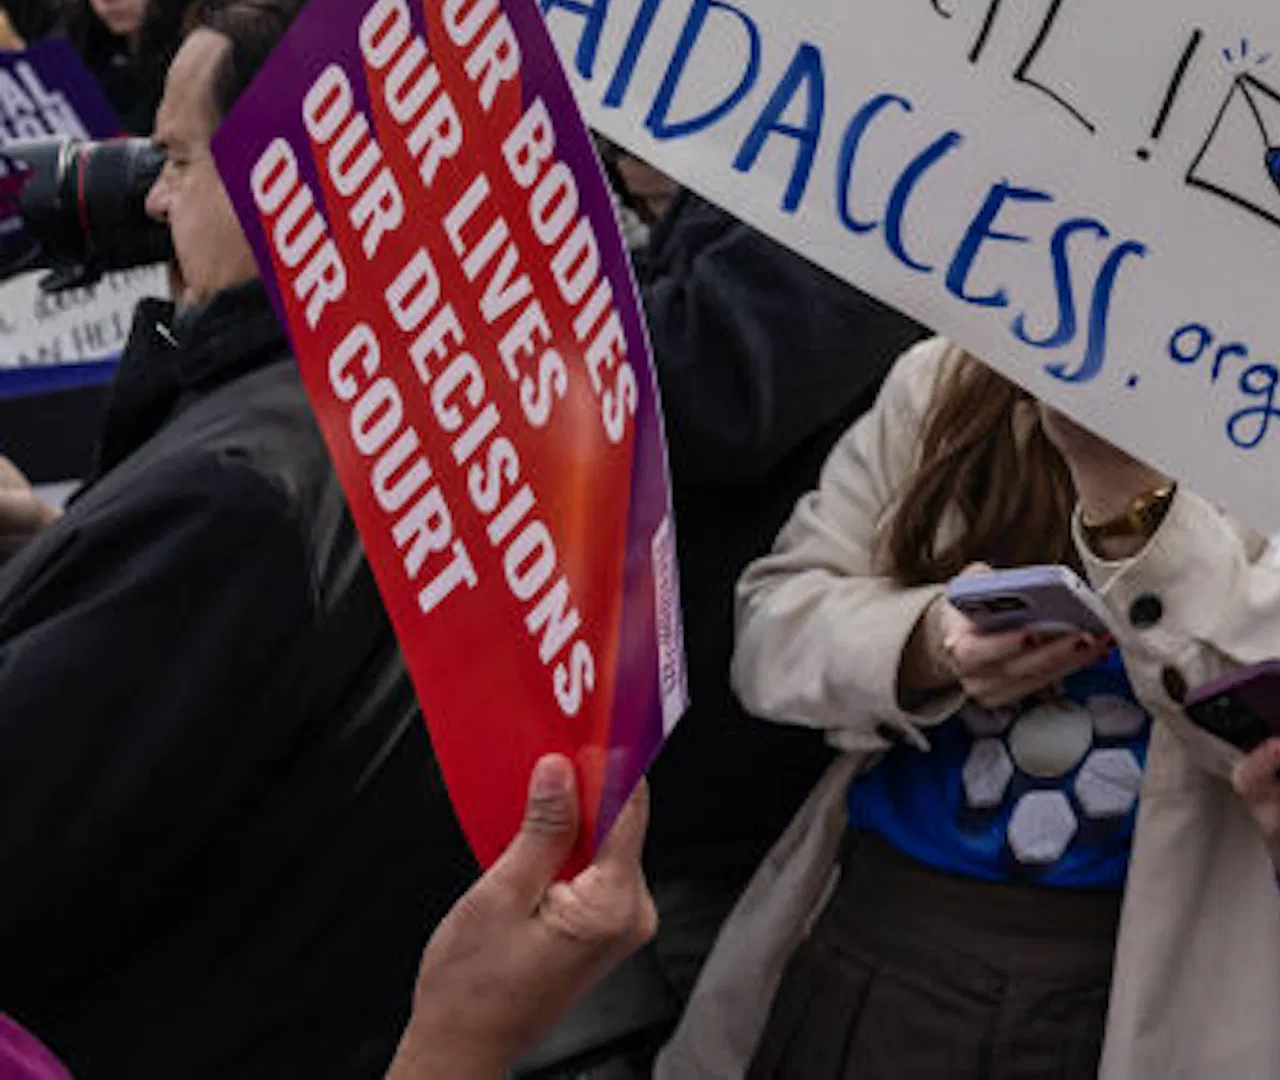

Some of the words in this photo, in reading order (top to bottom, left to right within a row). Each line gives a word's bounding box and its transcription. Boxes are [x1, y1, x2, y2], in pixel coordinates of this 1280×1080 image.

[249, 135, 348, 331] OUR
[326, 322, 479, 615] COURT
[301, 62, 406, 260] OUR
[383, 246, 596, 717] DECISIONS
[443, 173, 568, 428] LIVES
[501, 93, 640, 444] BODIES
